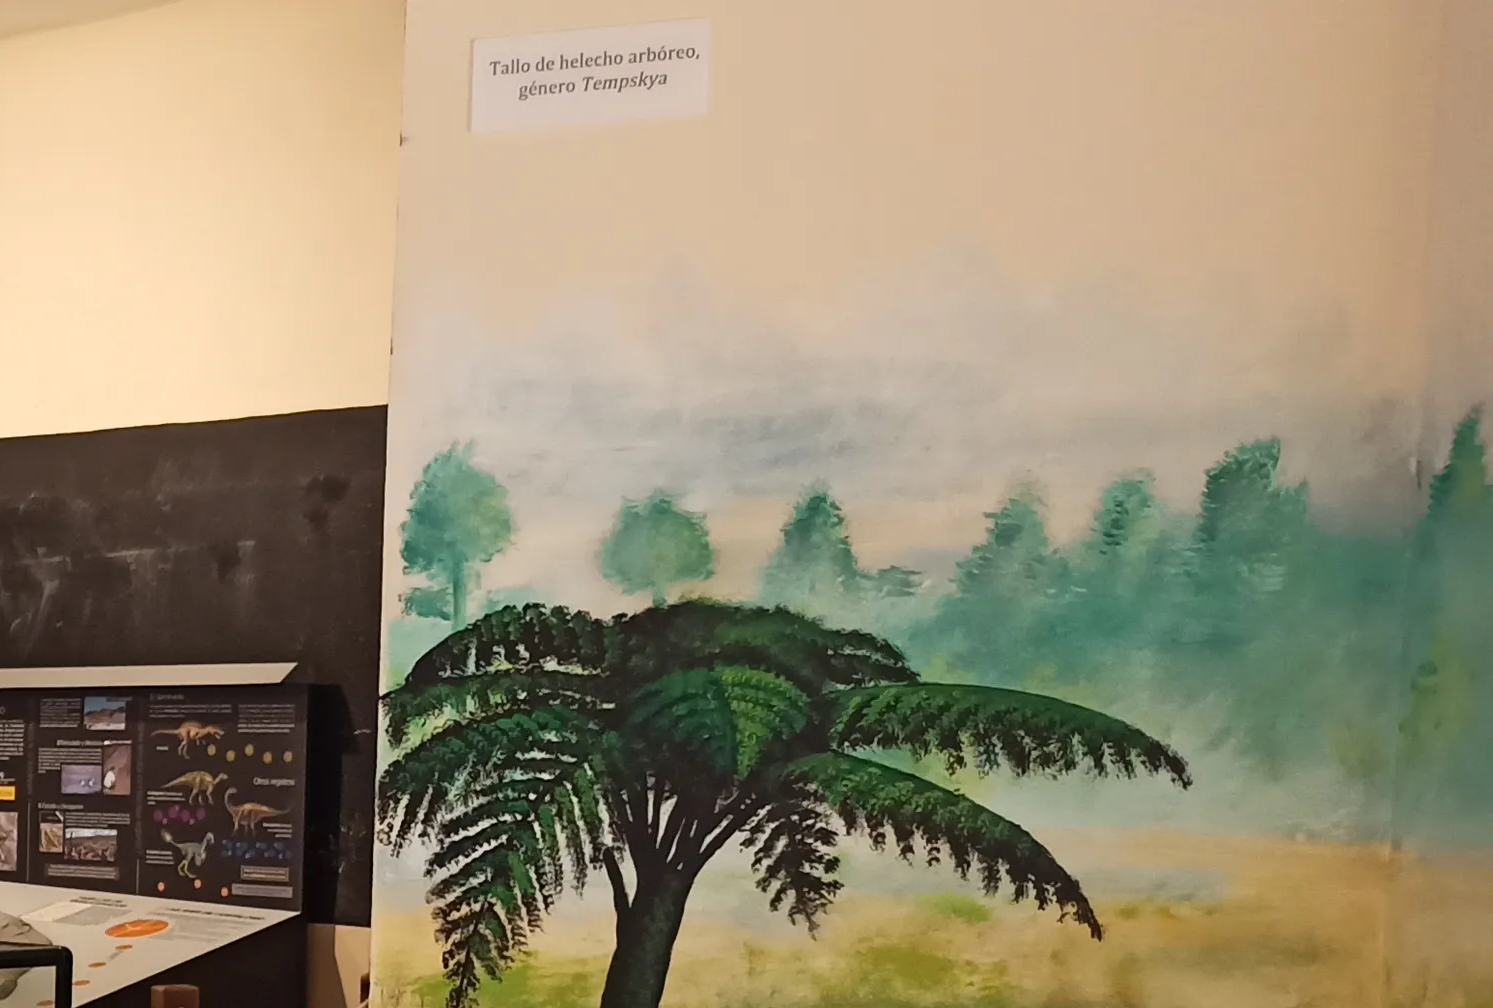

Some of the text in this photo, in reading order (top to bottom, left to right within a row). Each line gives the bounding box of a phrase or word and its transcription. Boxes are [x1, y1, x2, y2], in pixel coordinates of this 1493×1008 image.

[489, 45, 701, 76] Tallo de helecho arbóreo,
[518, 71, 668, 101] género Tempskya
